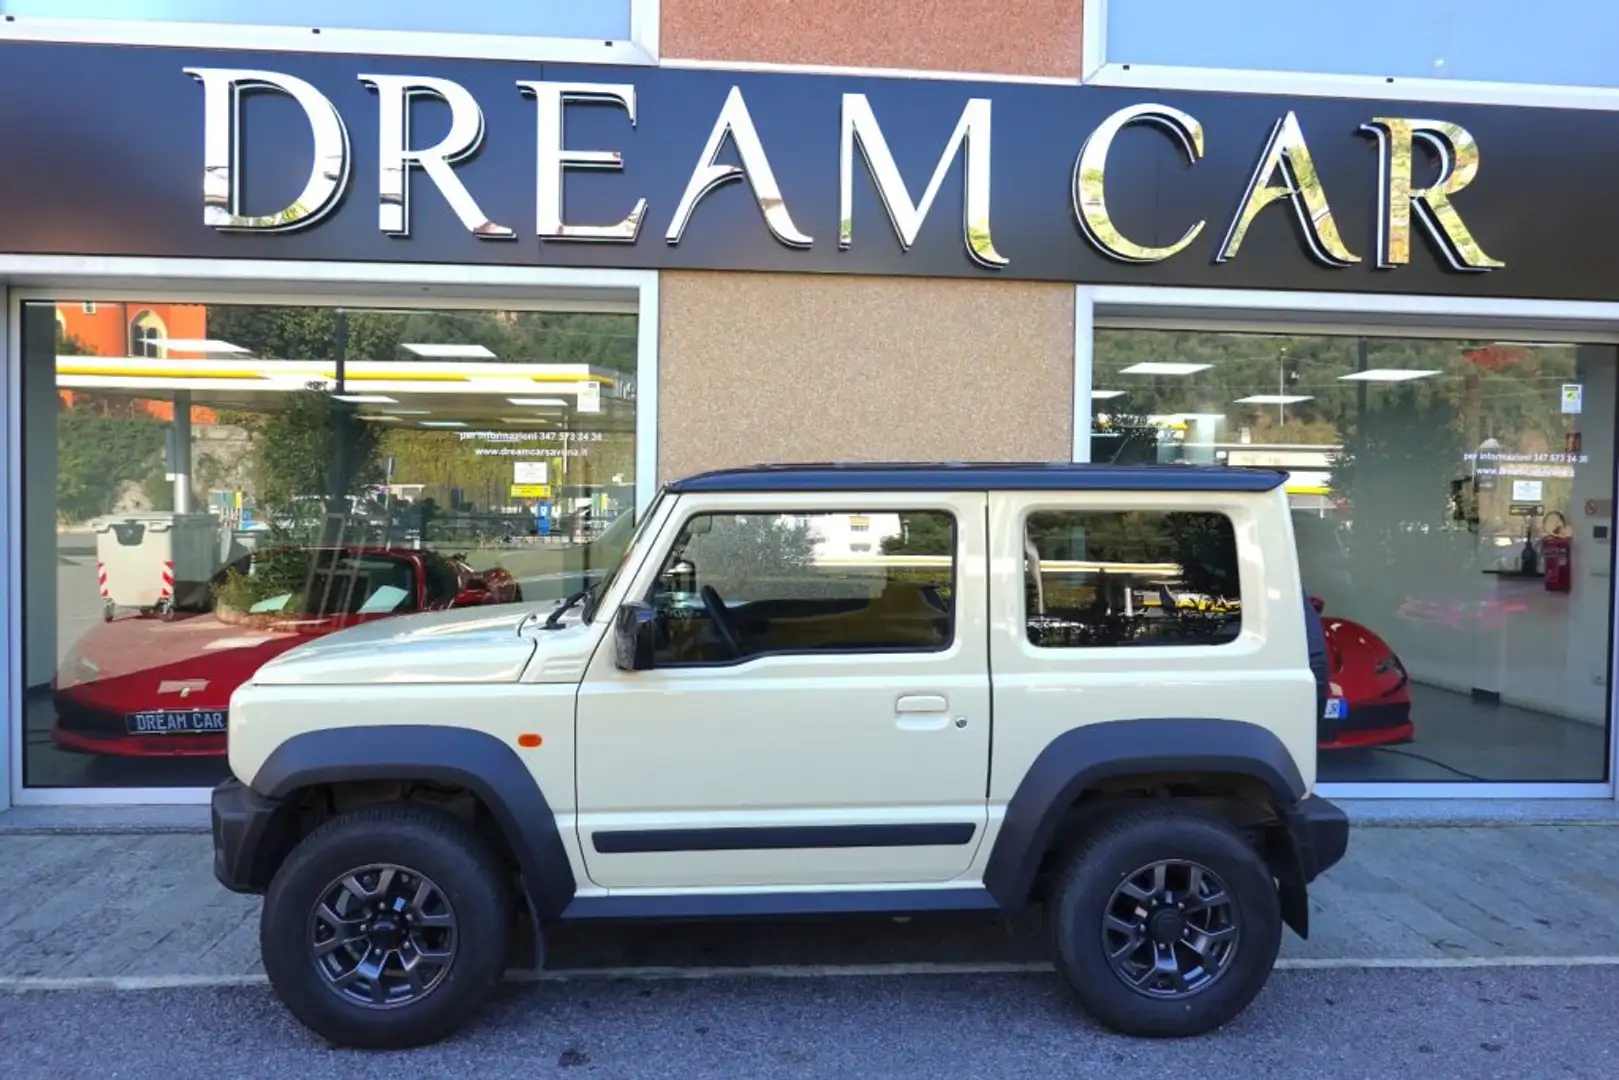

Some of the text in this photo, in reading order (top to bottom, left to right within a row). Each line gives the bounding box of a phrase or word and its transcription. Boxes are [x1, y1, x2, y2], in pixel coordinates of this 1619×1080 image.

[182, 66, 1506, 273] DREAM CAR
[135, 713, 224, 730] DREAM CAR
